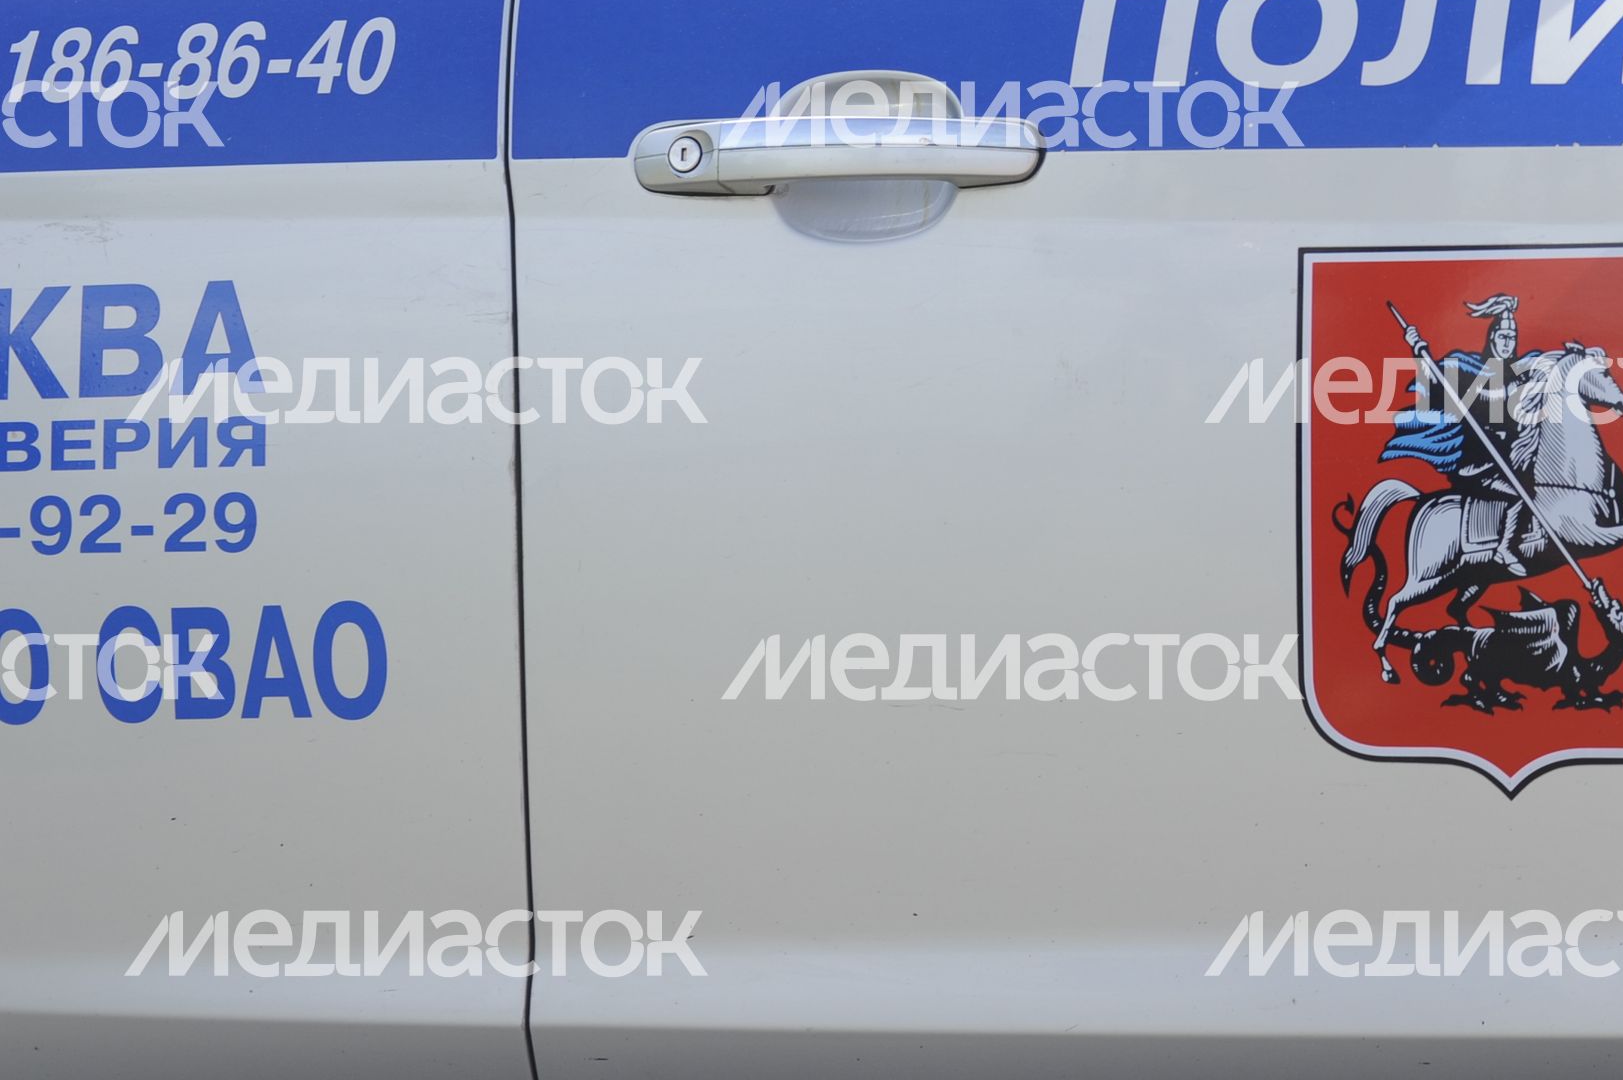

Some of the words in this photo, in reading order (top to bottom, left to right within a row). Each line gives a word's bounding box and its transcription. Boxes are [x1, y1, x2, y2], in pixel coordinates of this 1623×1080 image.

[8, 17, 396, 103] 186-86-40
[0, 280, 266, 400] КВА
[0, 415, 266, 472] ВЕРИЯ
[97, 600, 388, 724] СВАО
